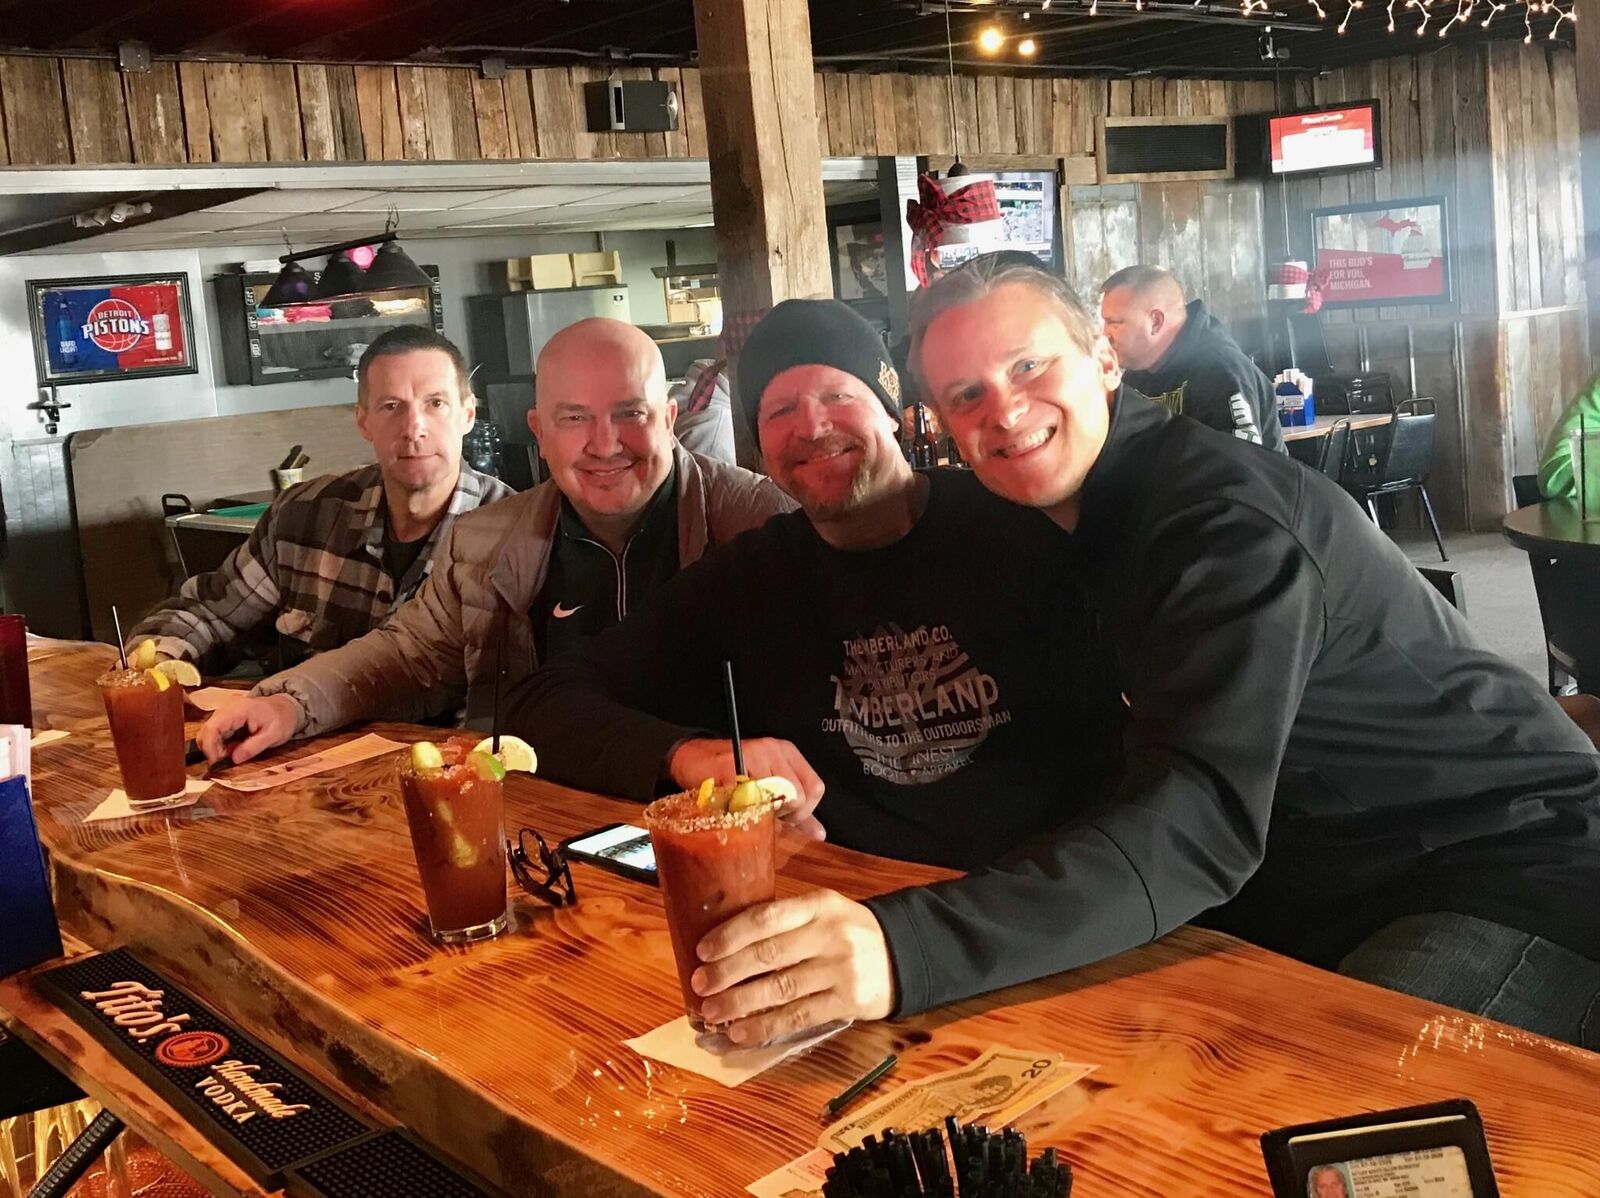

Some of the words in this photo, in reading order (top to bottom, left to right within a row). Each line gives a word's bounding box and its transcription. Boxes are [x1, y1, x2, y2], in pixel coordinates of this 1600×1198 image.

[1329, 259, 1347, 269] THIS
[1348, 256, 1373, 268] BUD'S
[1330, 270, 1345, 280] FOR
[98, 310, 132, 319] DETROIT
[81, 318, 150, 339] PISTONS
[931, 625, 953, 643] CO.
[885, 733, 900, 748] TO
[901, 731, 924, 746] THE
[80, 981, 191, 1043] Tito's
[1021, 1058, 1052, 1080] 20
[211, 1060, 310, 1119] Handmade
[195, 1076, 256, 1124] VODKA
